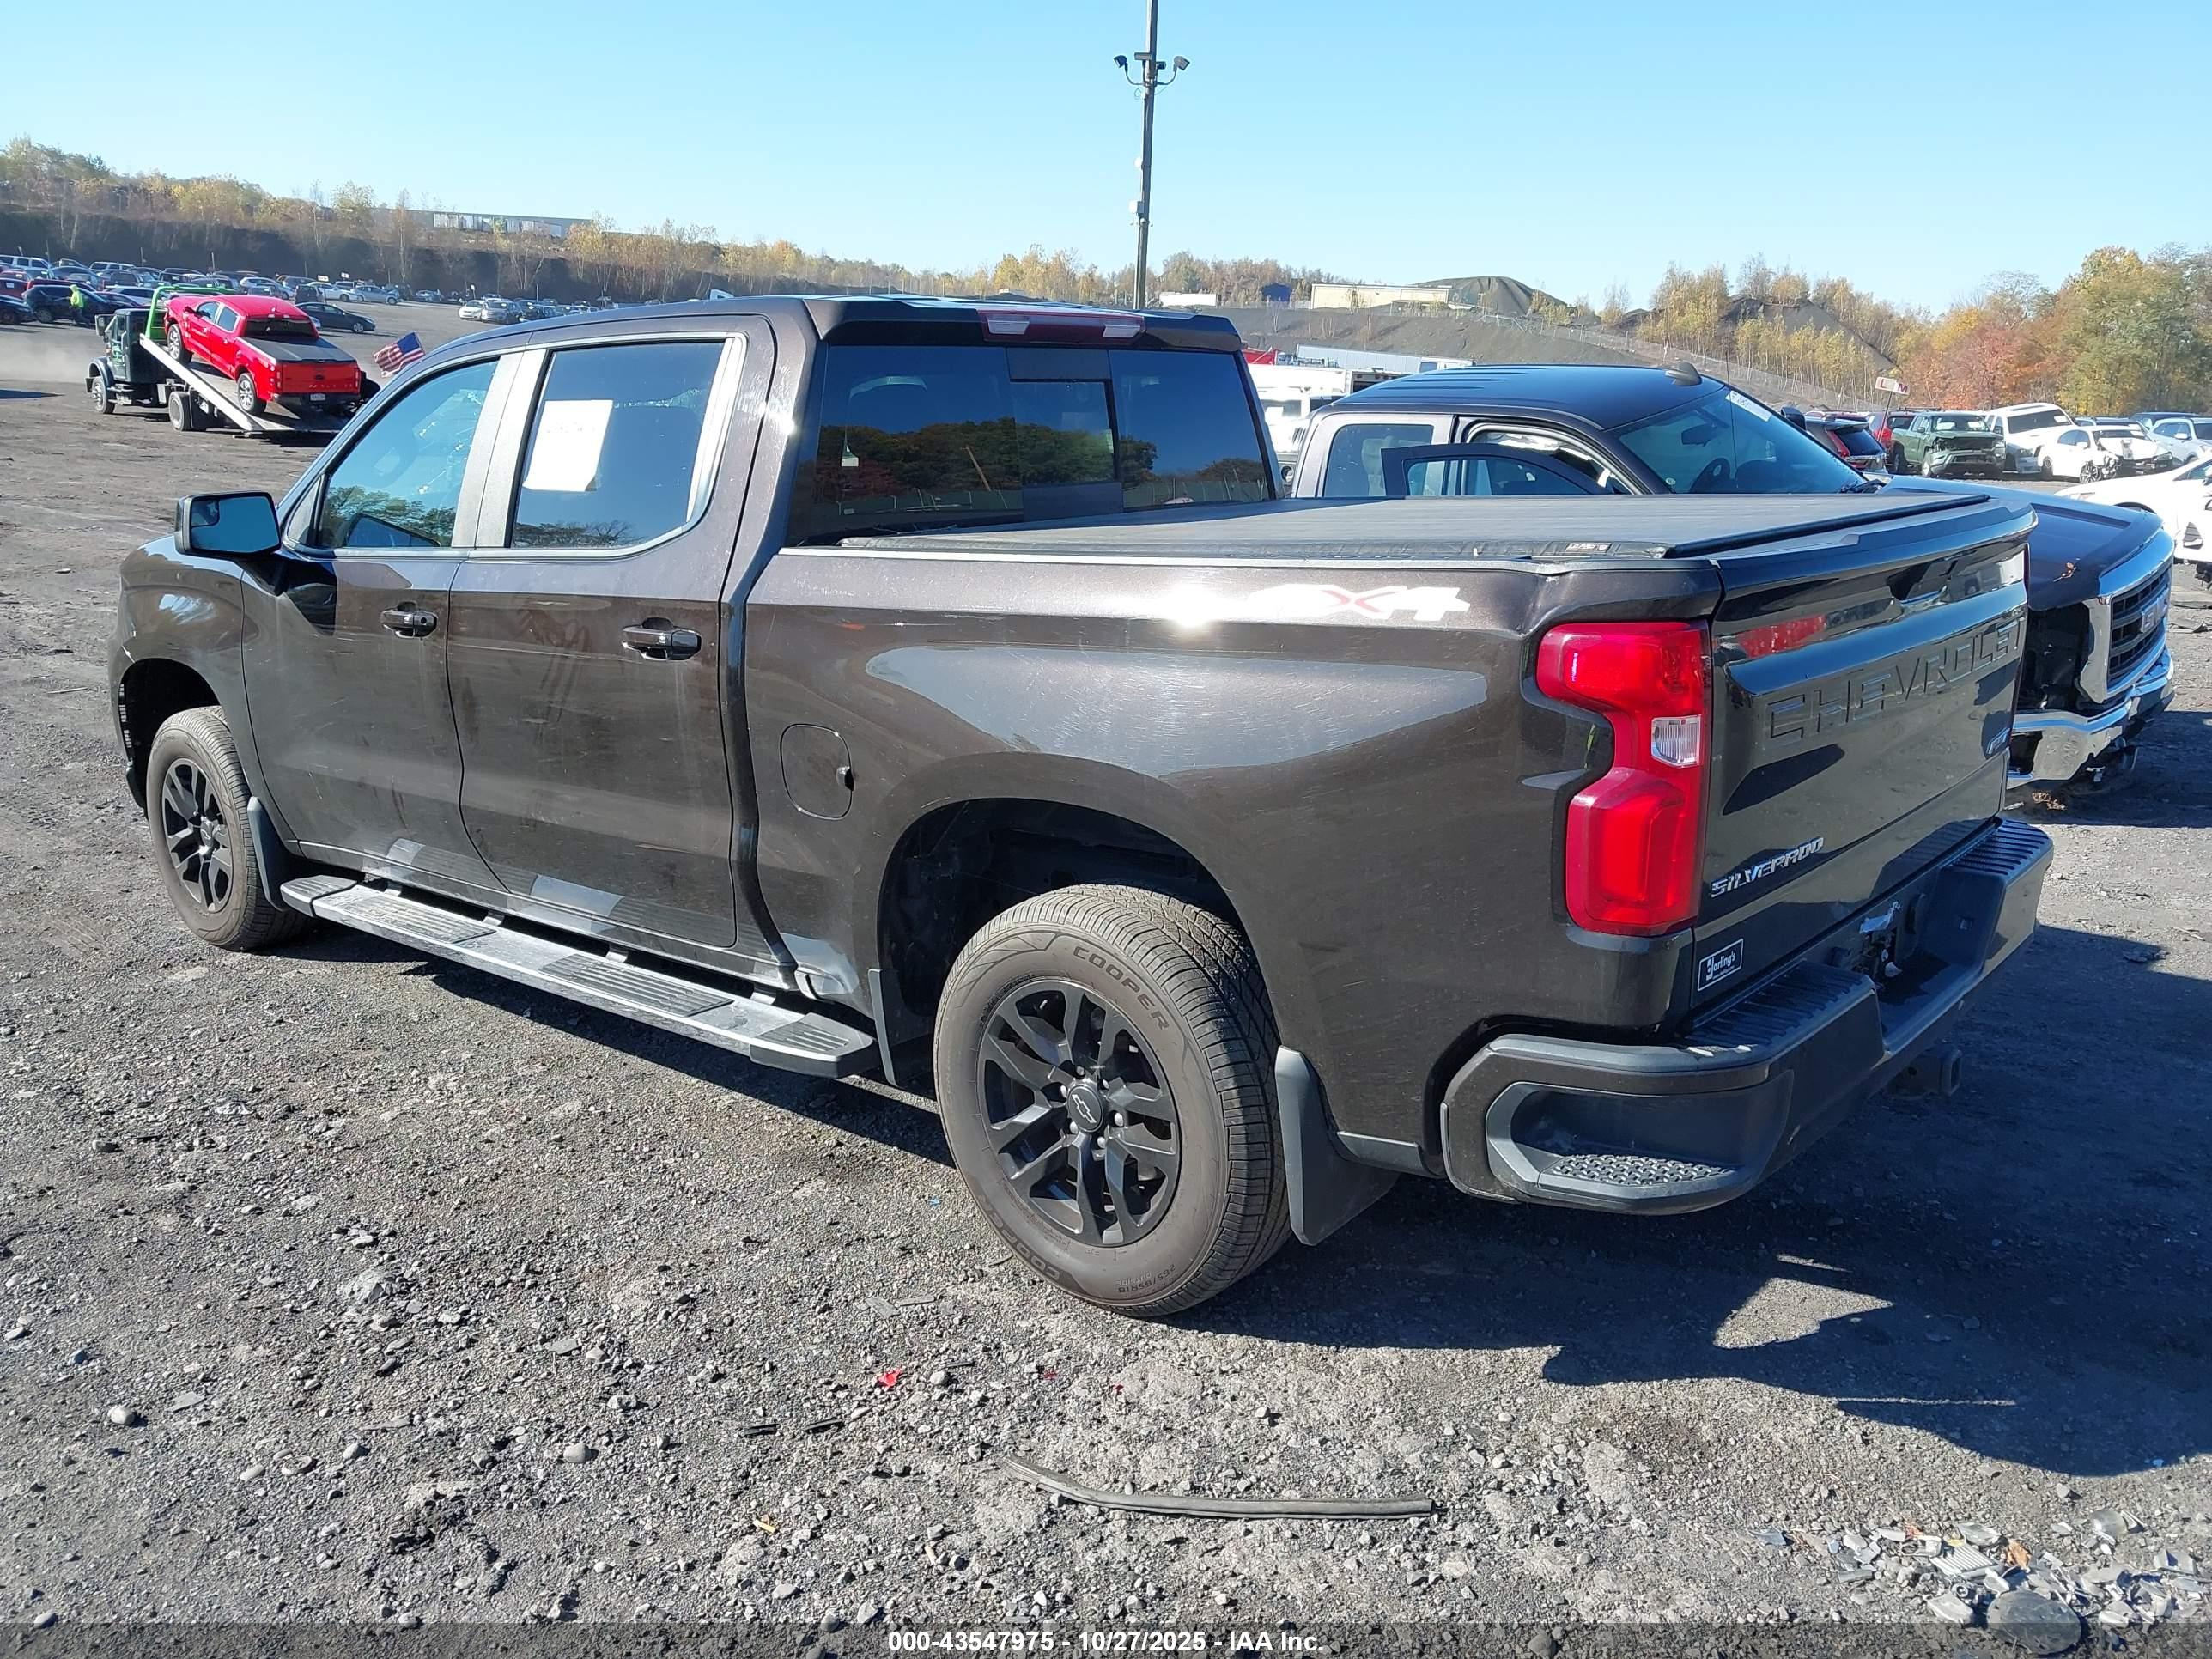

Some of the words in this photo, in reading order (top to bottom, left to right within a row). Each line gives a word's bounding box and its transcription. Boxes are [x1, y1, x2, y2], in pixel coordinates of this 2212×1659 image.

[1898, 383, 1909, 393] M
[1248, 583, 1471, 622] X4
[1763, 617, 2024, 750] CHEVROLET
[1711, 836, 1824, 898] SILVERADO
[1073, 945, 1170, 1030] COOPER
[1118, 1263, 1176, 1294] 265/65R18
